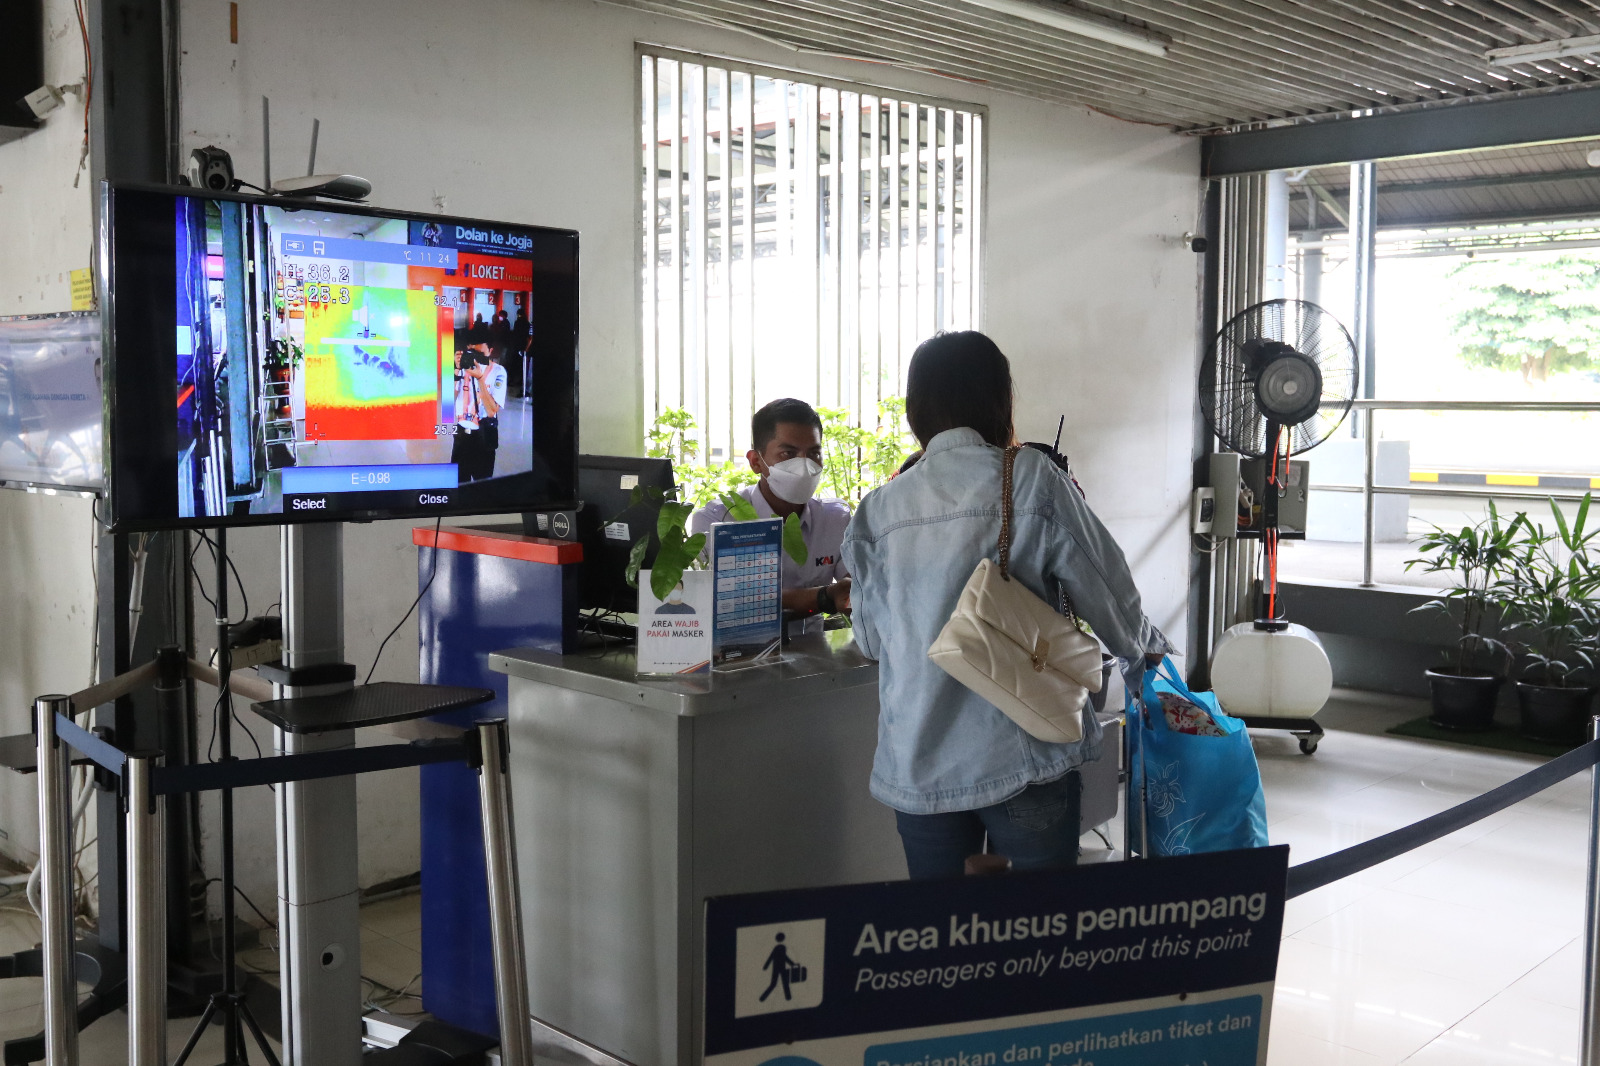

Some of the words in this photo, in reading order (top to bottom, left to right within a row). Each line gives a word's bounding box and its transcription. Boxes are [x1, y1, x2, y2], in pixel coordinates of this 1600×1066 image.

[456, 226, 488, 242] Dolan
[491, 230, 504, 244] ke
[505, 233, 533, 249] Jogja
[284, 263, 304, 279] H:
[308, 263, 350, 283] 36.2
[472, 264, 505, 280] LOKET
[308, 285, 350, 304] 25.3
[461, 292, 466, 302] 1
[489, 295, 494, 305] 2
[515, 295, 521, 305] 3
[433, 295, 458, 307] 32.1
[434, 425, 459, 435] 25.2
[292, 498, 326, 510] Select
[419, 493, 448, 504] Close
[554, 521, 568, 529] DELL
[816, 555, 833, 567] KAI
[651, 620, 673, 628] AREA
[674, 620, 700, 628] WAJIB
[672, 630, 704, 638] MASKER
[853, 923, 939, 956] Area
[949, 913, 1068, 947] khusus
[1076, 892, 1267, 941] penumpang
[855, 961, 997, 993] Passengers
[1003, 949, 1055, 977] only
[1059, 937, 1147, 971] beyond
[1151, 934, 1191, 958] this
[1195, 928, 1252, 959] point
[1003, 1044, 1042, 1063] dan
[1048, 1028, 1163, 1061] perlihatkan
[1168, 1019, 1213, 1039] tiket
[1218, 1014, 1251, 1033] dan
